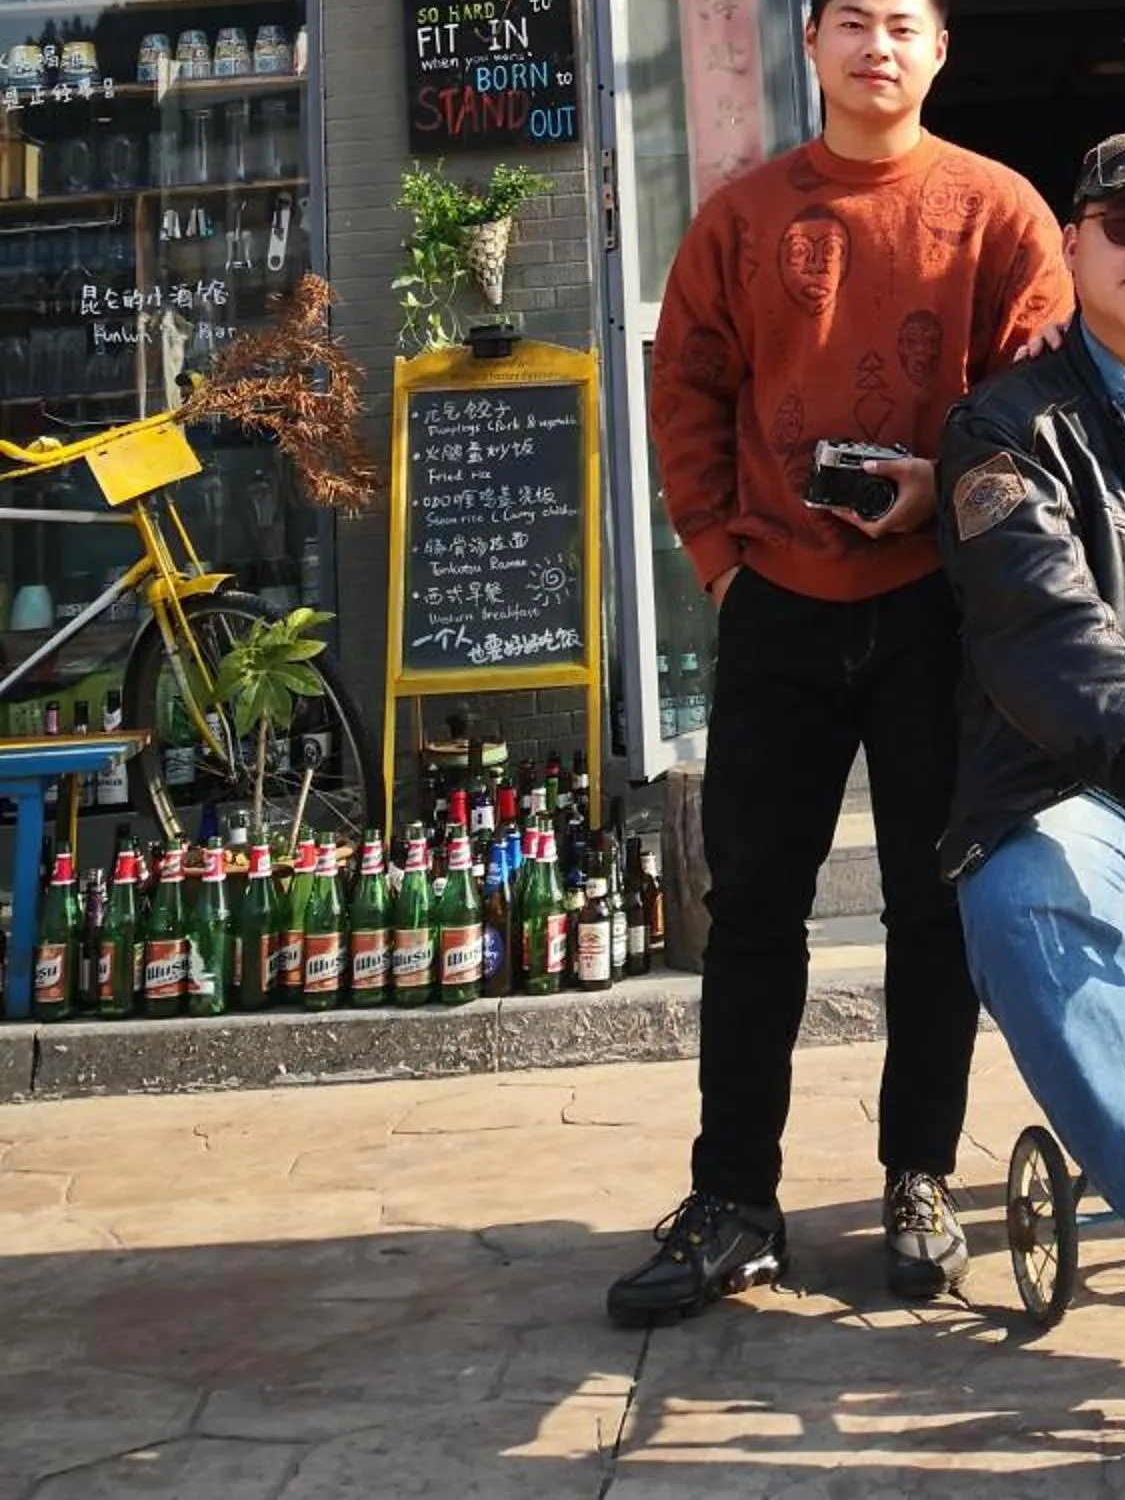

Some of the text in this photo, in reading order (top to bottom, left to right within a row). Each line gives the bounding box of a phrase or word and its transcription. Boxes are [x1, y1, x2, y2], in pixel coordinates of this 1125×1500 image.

[417, 5, 439, 24] SO
[449, 1, 496, 23] HARD
[417, 16, 530, 57] FIT IN
[421, 56, 459, 72] when
[476, 62, 573, 92] BORN to
[414, 84, 576, 138] STAND OUT
[80, 279, 229, 315] 昆仑的小酒馆
